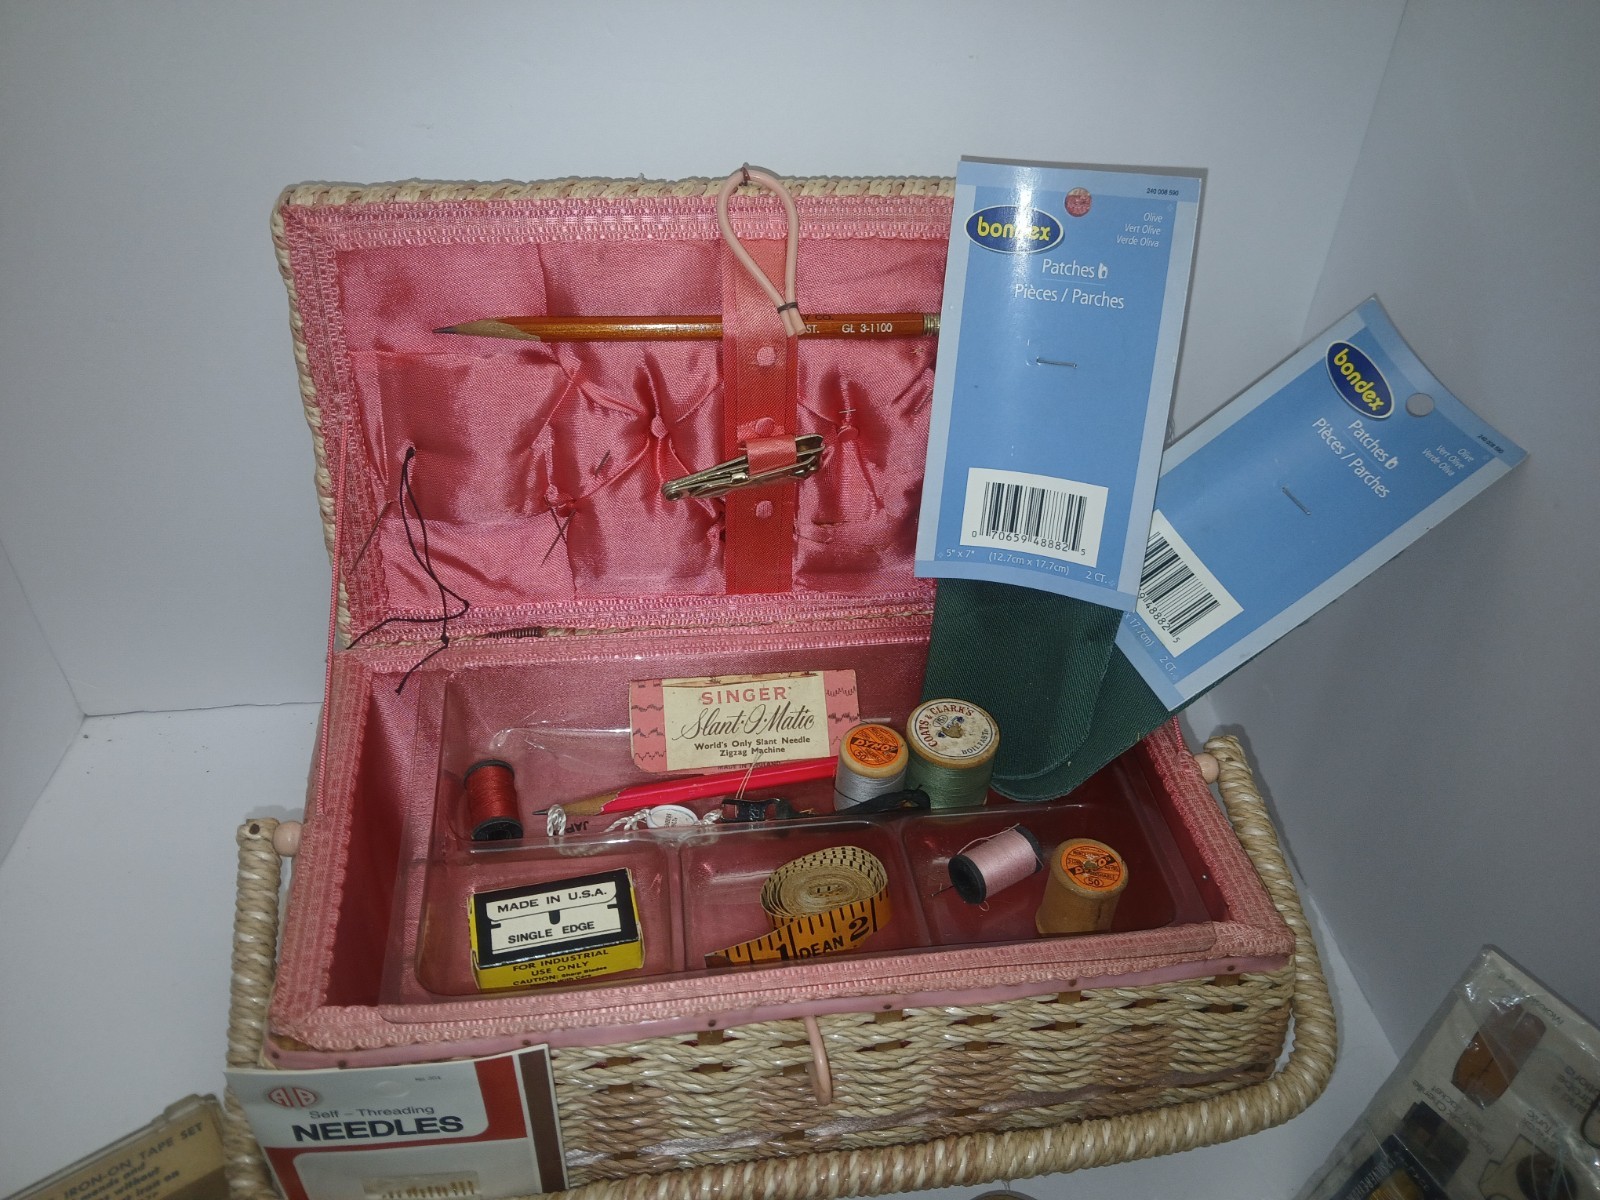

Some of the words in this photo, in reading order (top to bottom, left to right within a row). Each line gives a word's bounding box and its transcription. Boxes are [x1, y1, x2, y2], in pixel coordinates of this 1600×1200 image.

[977, 216, 1051, 241] bonex
[1144, 212, 1162, 222] Olive
[1116, 234, 1138, 246] Verde
[1140, 238, 1159, 248] Oliva
[1124, 224, 1140, 233] Vert
[1142, 224, 1160, 235] Olive
[1042, 258, 1095, 278] Patches
[1014, 284, 1058, 302] Pièces
[1072, 290, 1125, 310] Parches
[842, 324, 855, 333] GL
[860, 322, 892, 332] 3-1100
[1334, 348, 1384, 411] bondex
[1348, 419, 1389, 463] Patches
[1312, 418, 1346, 455] Pièces
[1348, 458, 1390, 498] Parches
[991, 530, 1028, 544] 70659
[1032, 537, 1068, 552] 48882
[1080, 548, 1086, 556] 5
[988, 552, 1024, 566] (12.7cm
[1036, 558, 1070, 576] 17.7cm)
[702, 686, 787, 705] SINGER
[918, 719, 938, 748] COATS
[930, 704, 974, 716] CLARK'S
[694, 742, 728, 750] World's
[732, 740, 752, 749] Only
[756, 738, 778, 746] Slant
[782, 736, 810, 744] Needle
[720, 748, 747, 758] Zigzag
[751, 746, 786, 755] Machine
[1088, 878, 1100, 886] 50
[497, 899, 539, 914] MADE
[546, 894, 560, 904] IN
[568, 888, 607, 900] U.S.A.
[508, 929, 553, 944] SINGLE
[562, 921, 595, 934] EDGE
[848, 916, 870, 942] 2
[776, 943, 790, 960] 1
[799, 936, 844, 959] DEAN
[513, 963, 536, 972] FOR
[541, 950, 608, 966] INDUSTRIAL
[532, 968, 552, 976] USE
[557, 961, 589, 972] ONLY
[513, 974, 558, 986] CAUTION:
[309, 1110, 339, 1119] Self
[358, 1106, 435, 1116] Threading
[292, 1116, 464, 1142] NEEDLES
[139, 1136, 174, 1160] TAPE
[180, 1122, 202, 1140] SET
